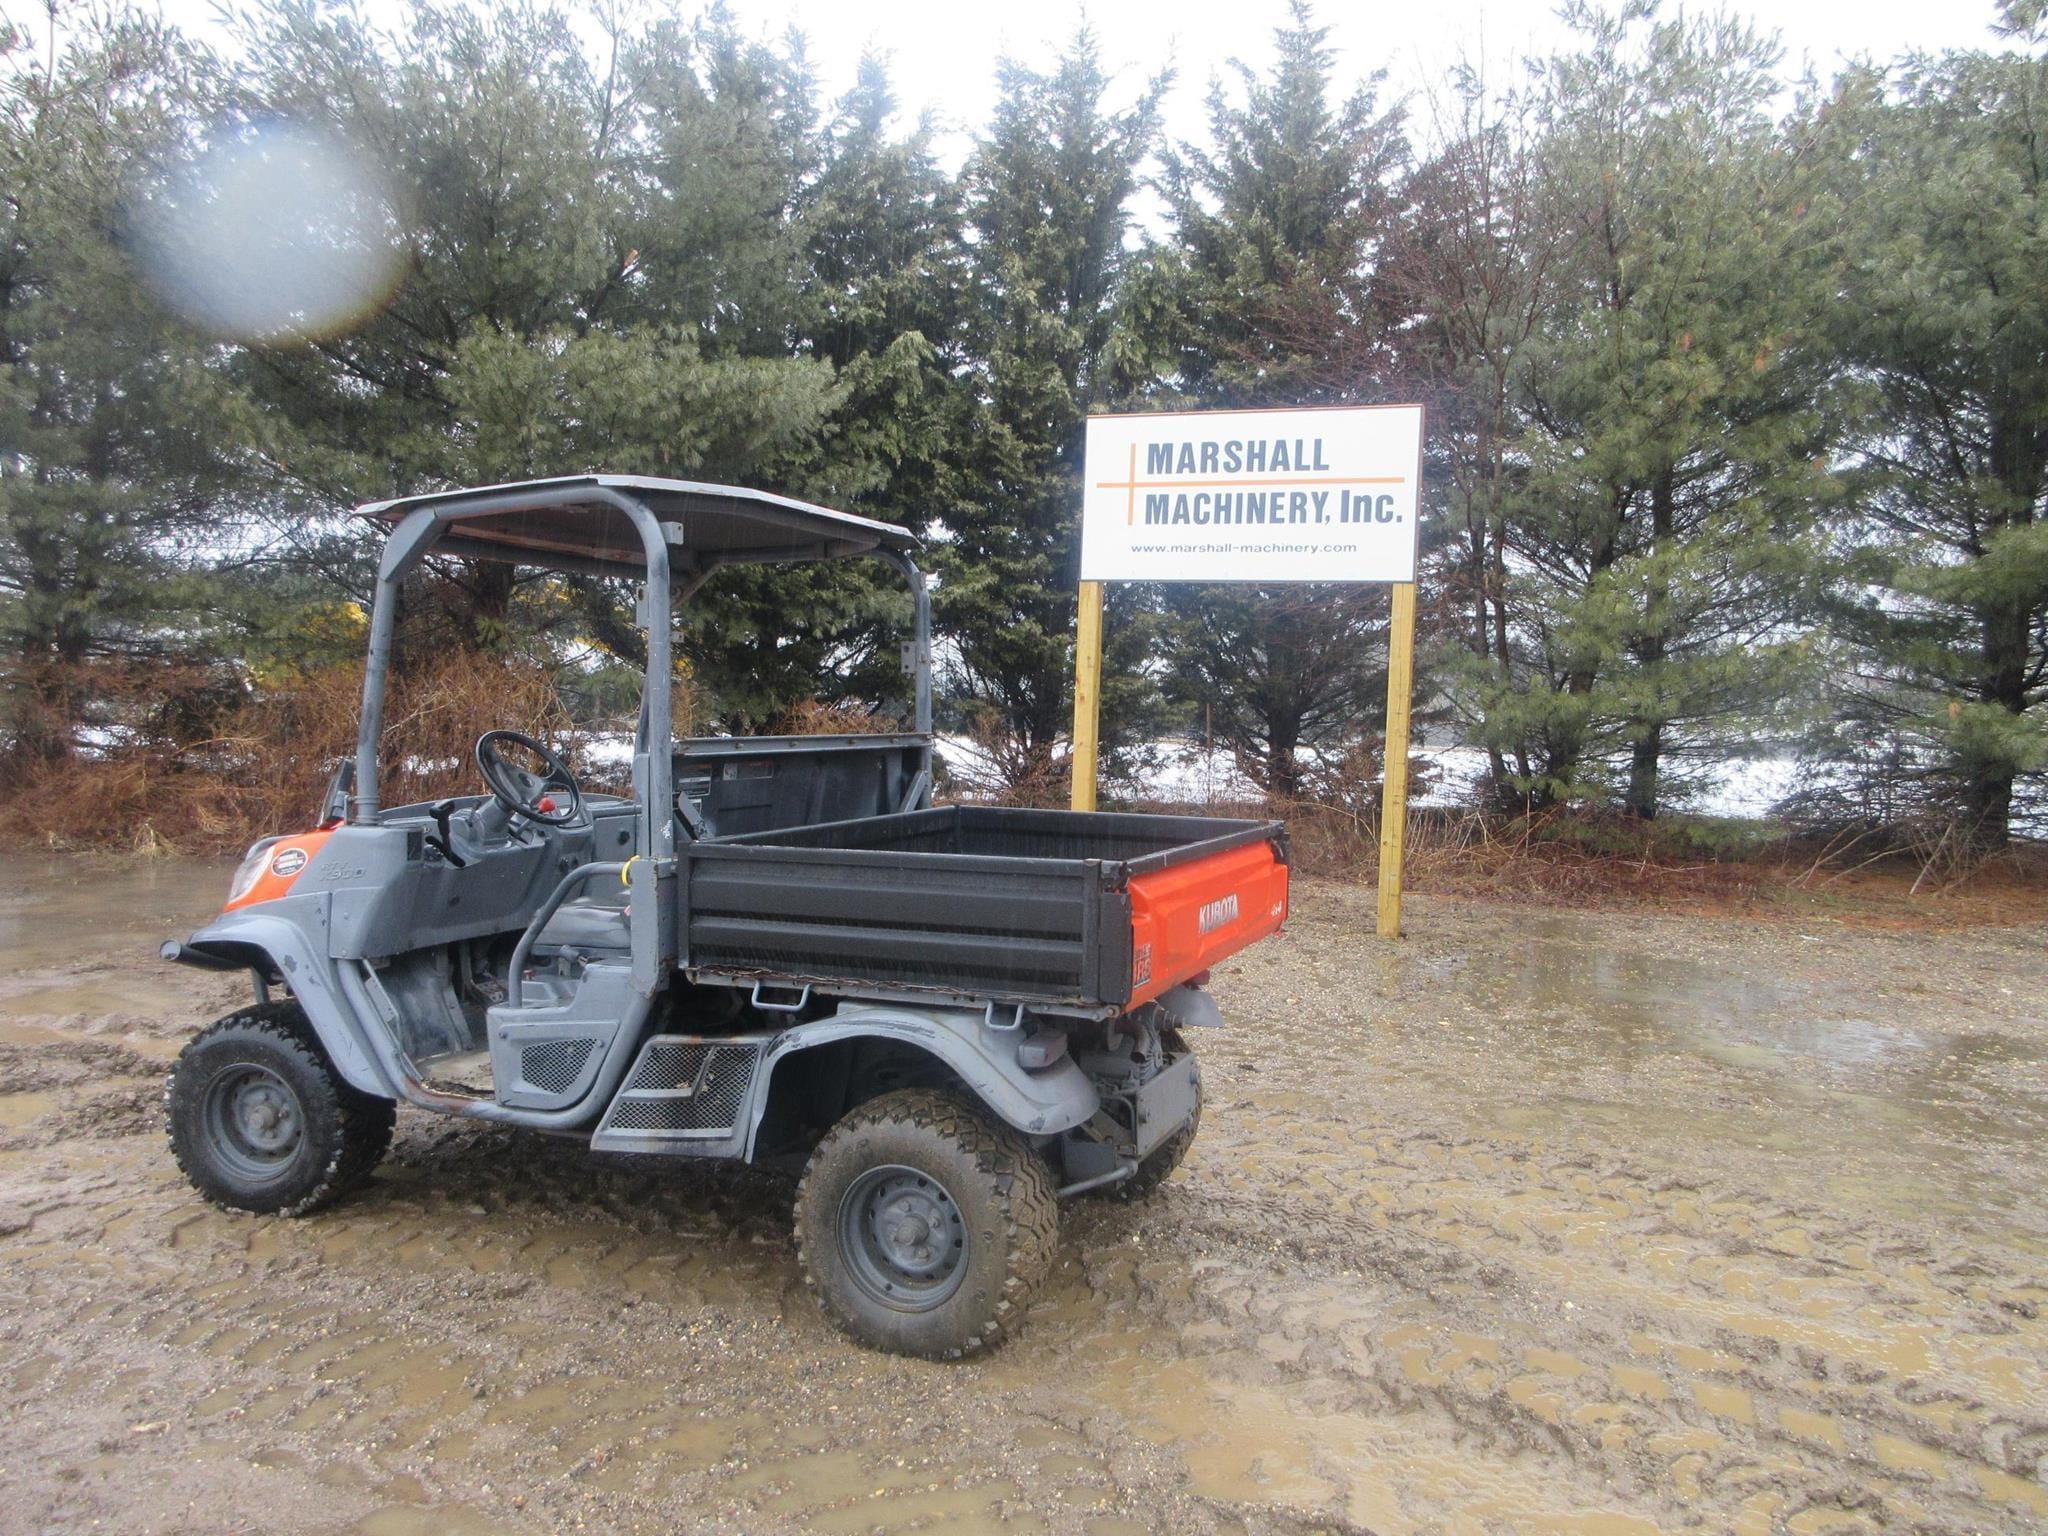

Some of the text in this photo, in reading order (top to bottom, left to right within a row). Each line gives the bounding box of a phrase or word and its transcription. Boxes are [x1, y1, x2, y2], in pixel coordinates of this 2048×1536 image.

[1147, 439, 1329, 474] MARSHALL
[1145, 490, 1403, 525] MACHINERY, Inc.
[1131, 543, 1357, 553] www.marshall-machinery.com
[1199, 894, 1238, 932] KUBOTA
